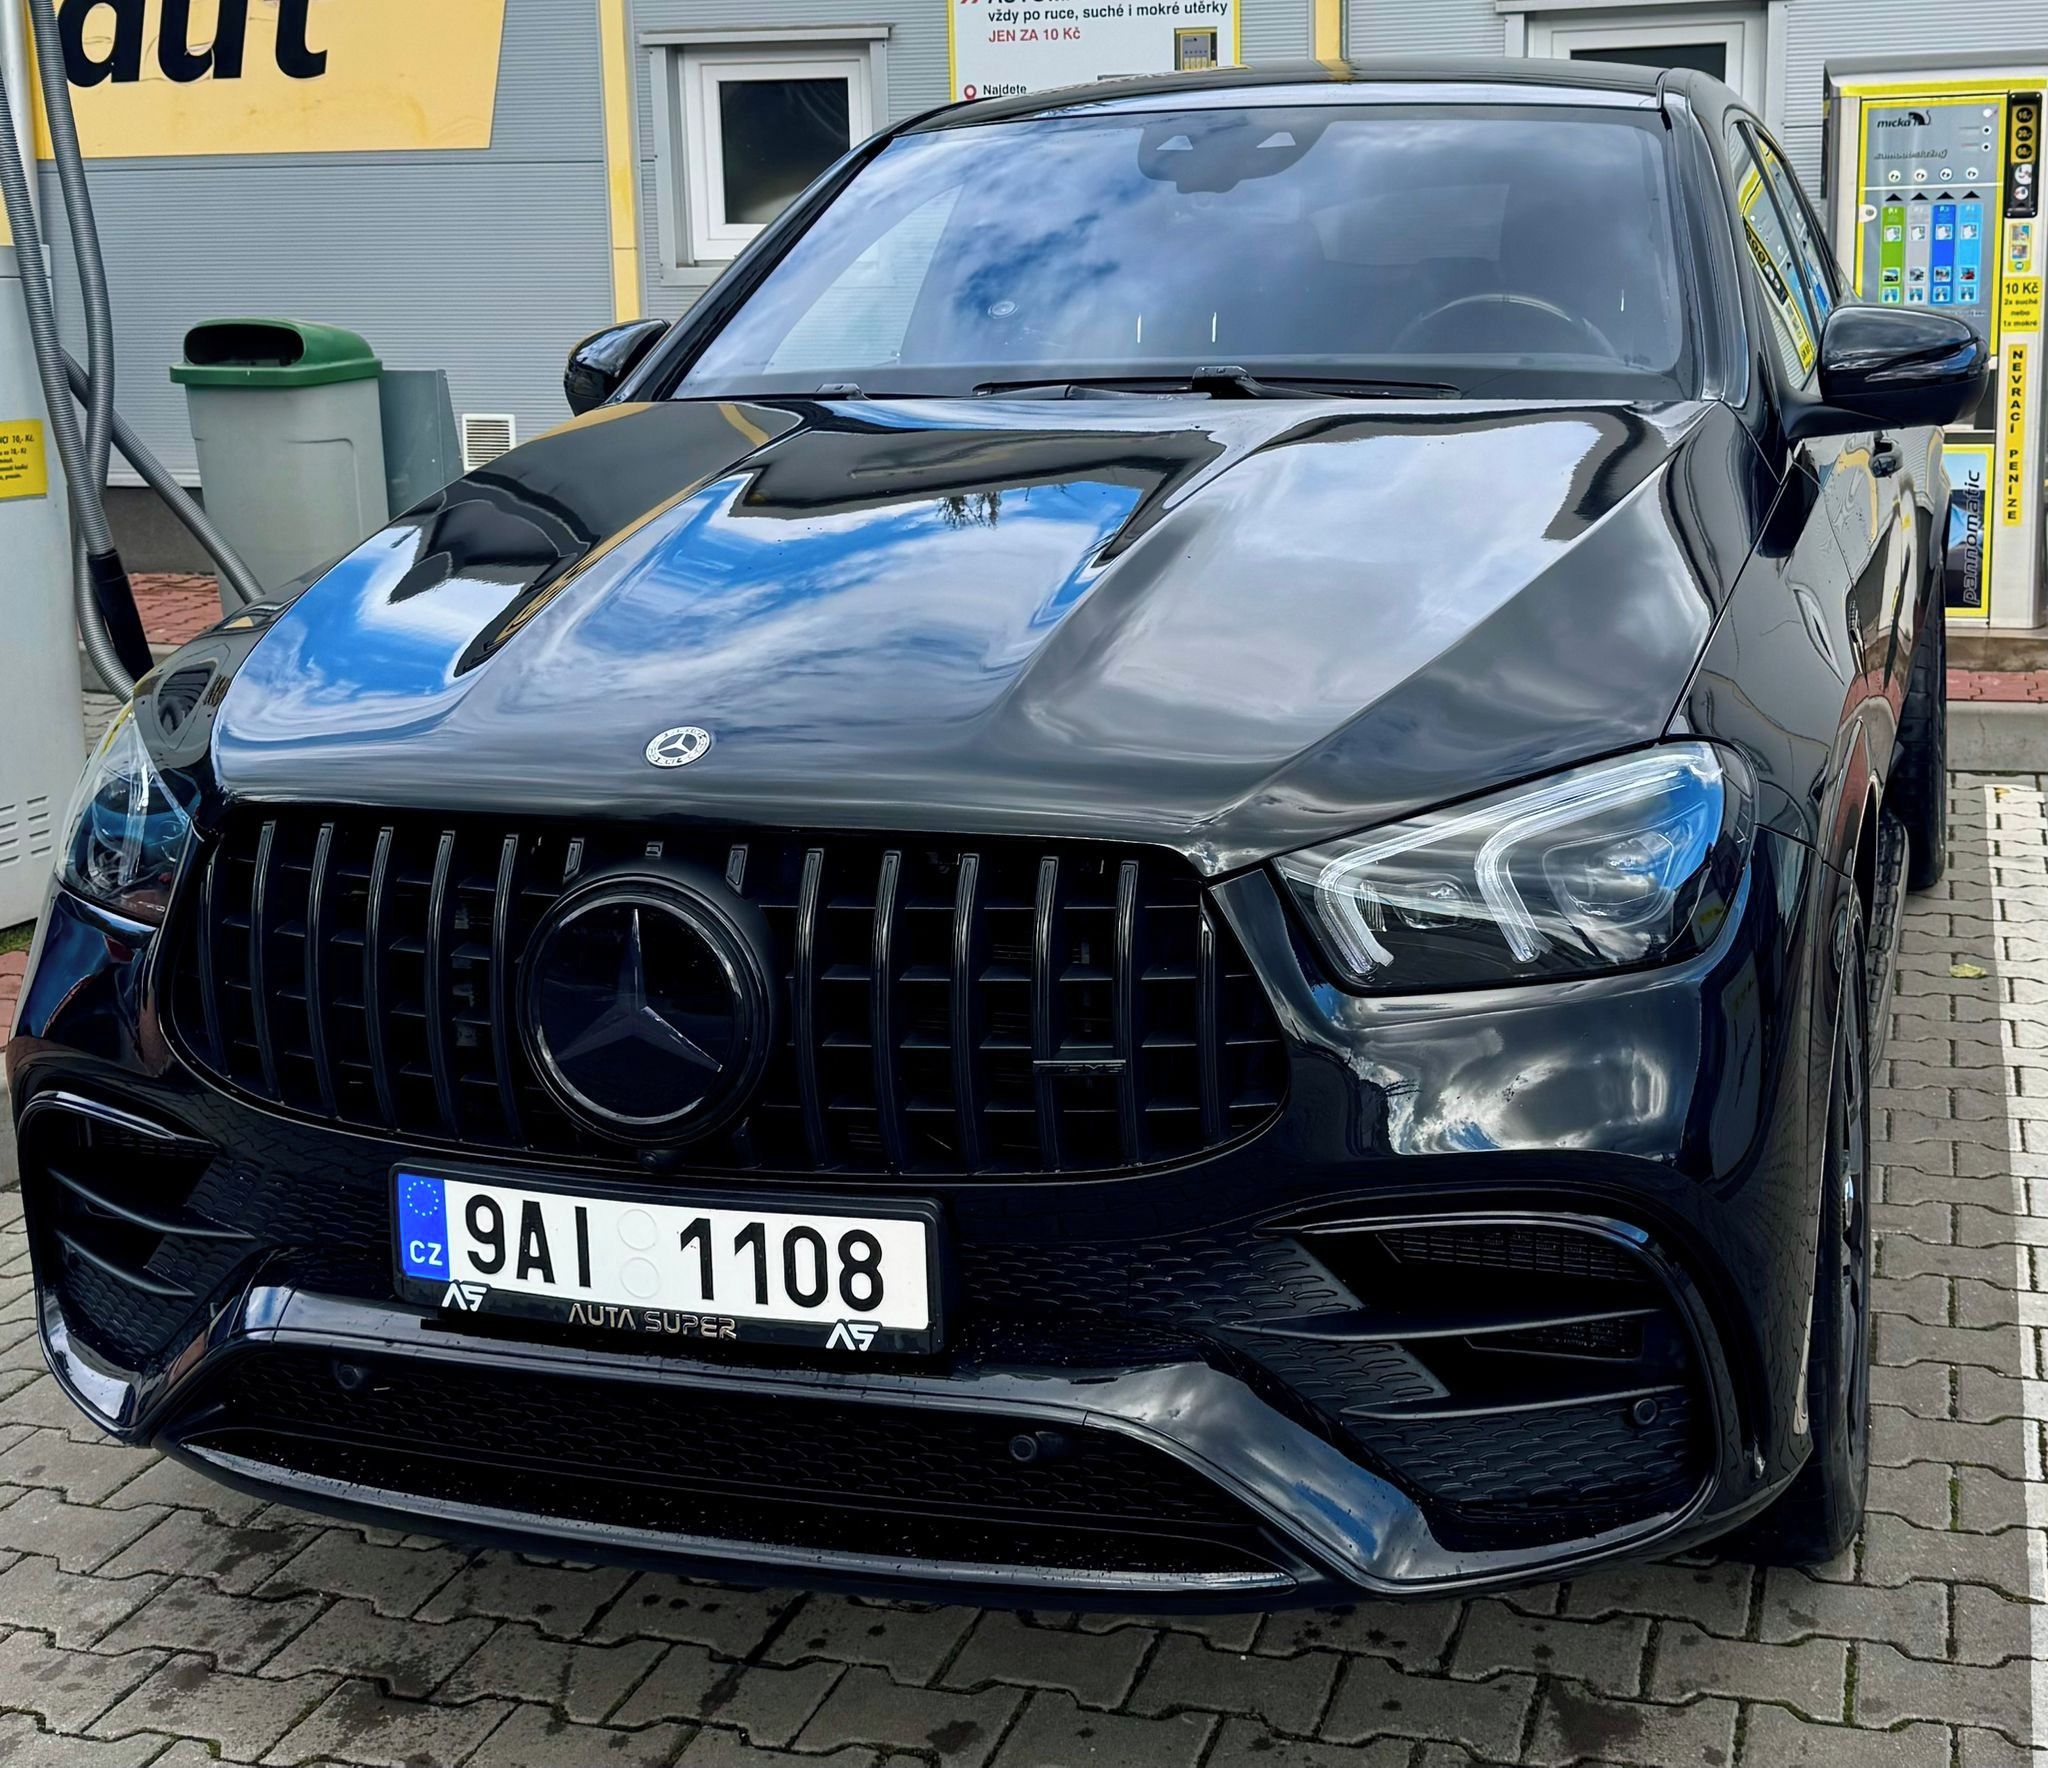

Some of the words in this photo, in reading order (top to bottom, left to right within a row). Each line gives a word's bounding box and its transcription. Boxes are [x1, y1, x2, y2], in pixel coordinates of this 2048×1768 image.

[988, 9, 1019, 24] vždy
[1023, 10, 1041, 24] po
[1045, 9, 1079, 20] ruce,
[1083, 4, 1124, 18] suché
[1128, 4, 1133, 16] i
[1136, 1, 1180, 16] mokré
[1184, 0, 1228, 16] utěrky
[988, 30, 1016, 42] JEN
[1020, 29, 1039, 41] ZA
[1043, 28, 1059, 40] 10
[1063, 26, 1081, 40] Kč
[2005, 282, 2019, 295] 10
[2022, 281, 2039, 295] Kč
[409, 1238, 443, 1267] CZ
[464, 1193, 593, 1289] 9AI
[679, 1217, 885, 1313] 1108
[568, 1302, 637, 1331] AUTA
[643, 1310, 738, 1341] SUPER
